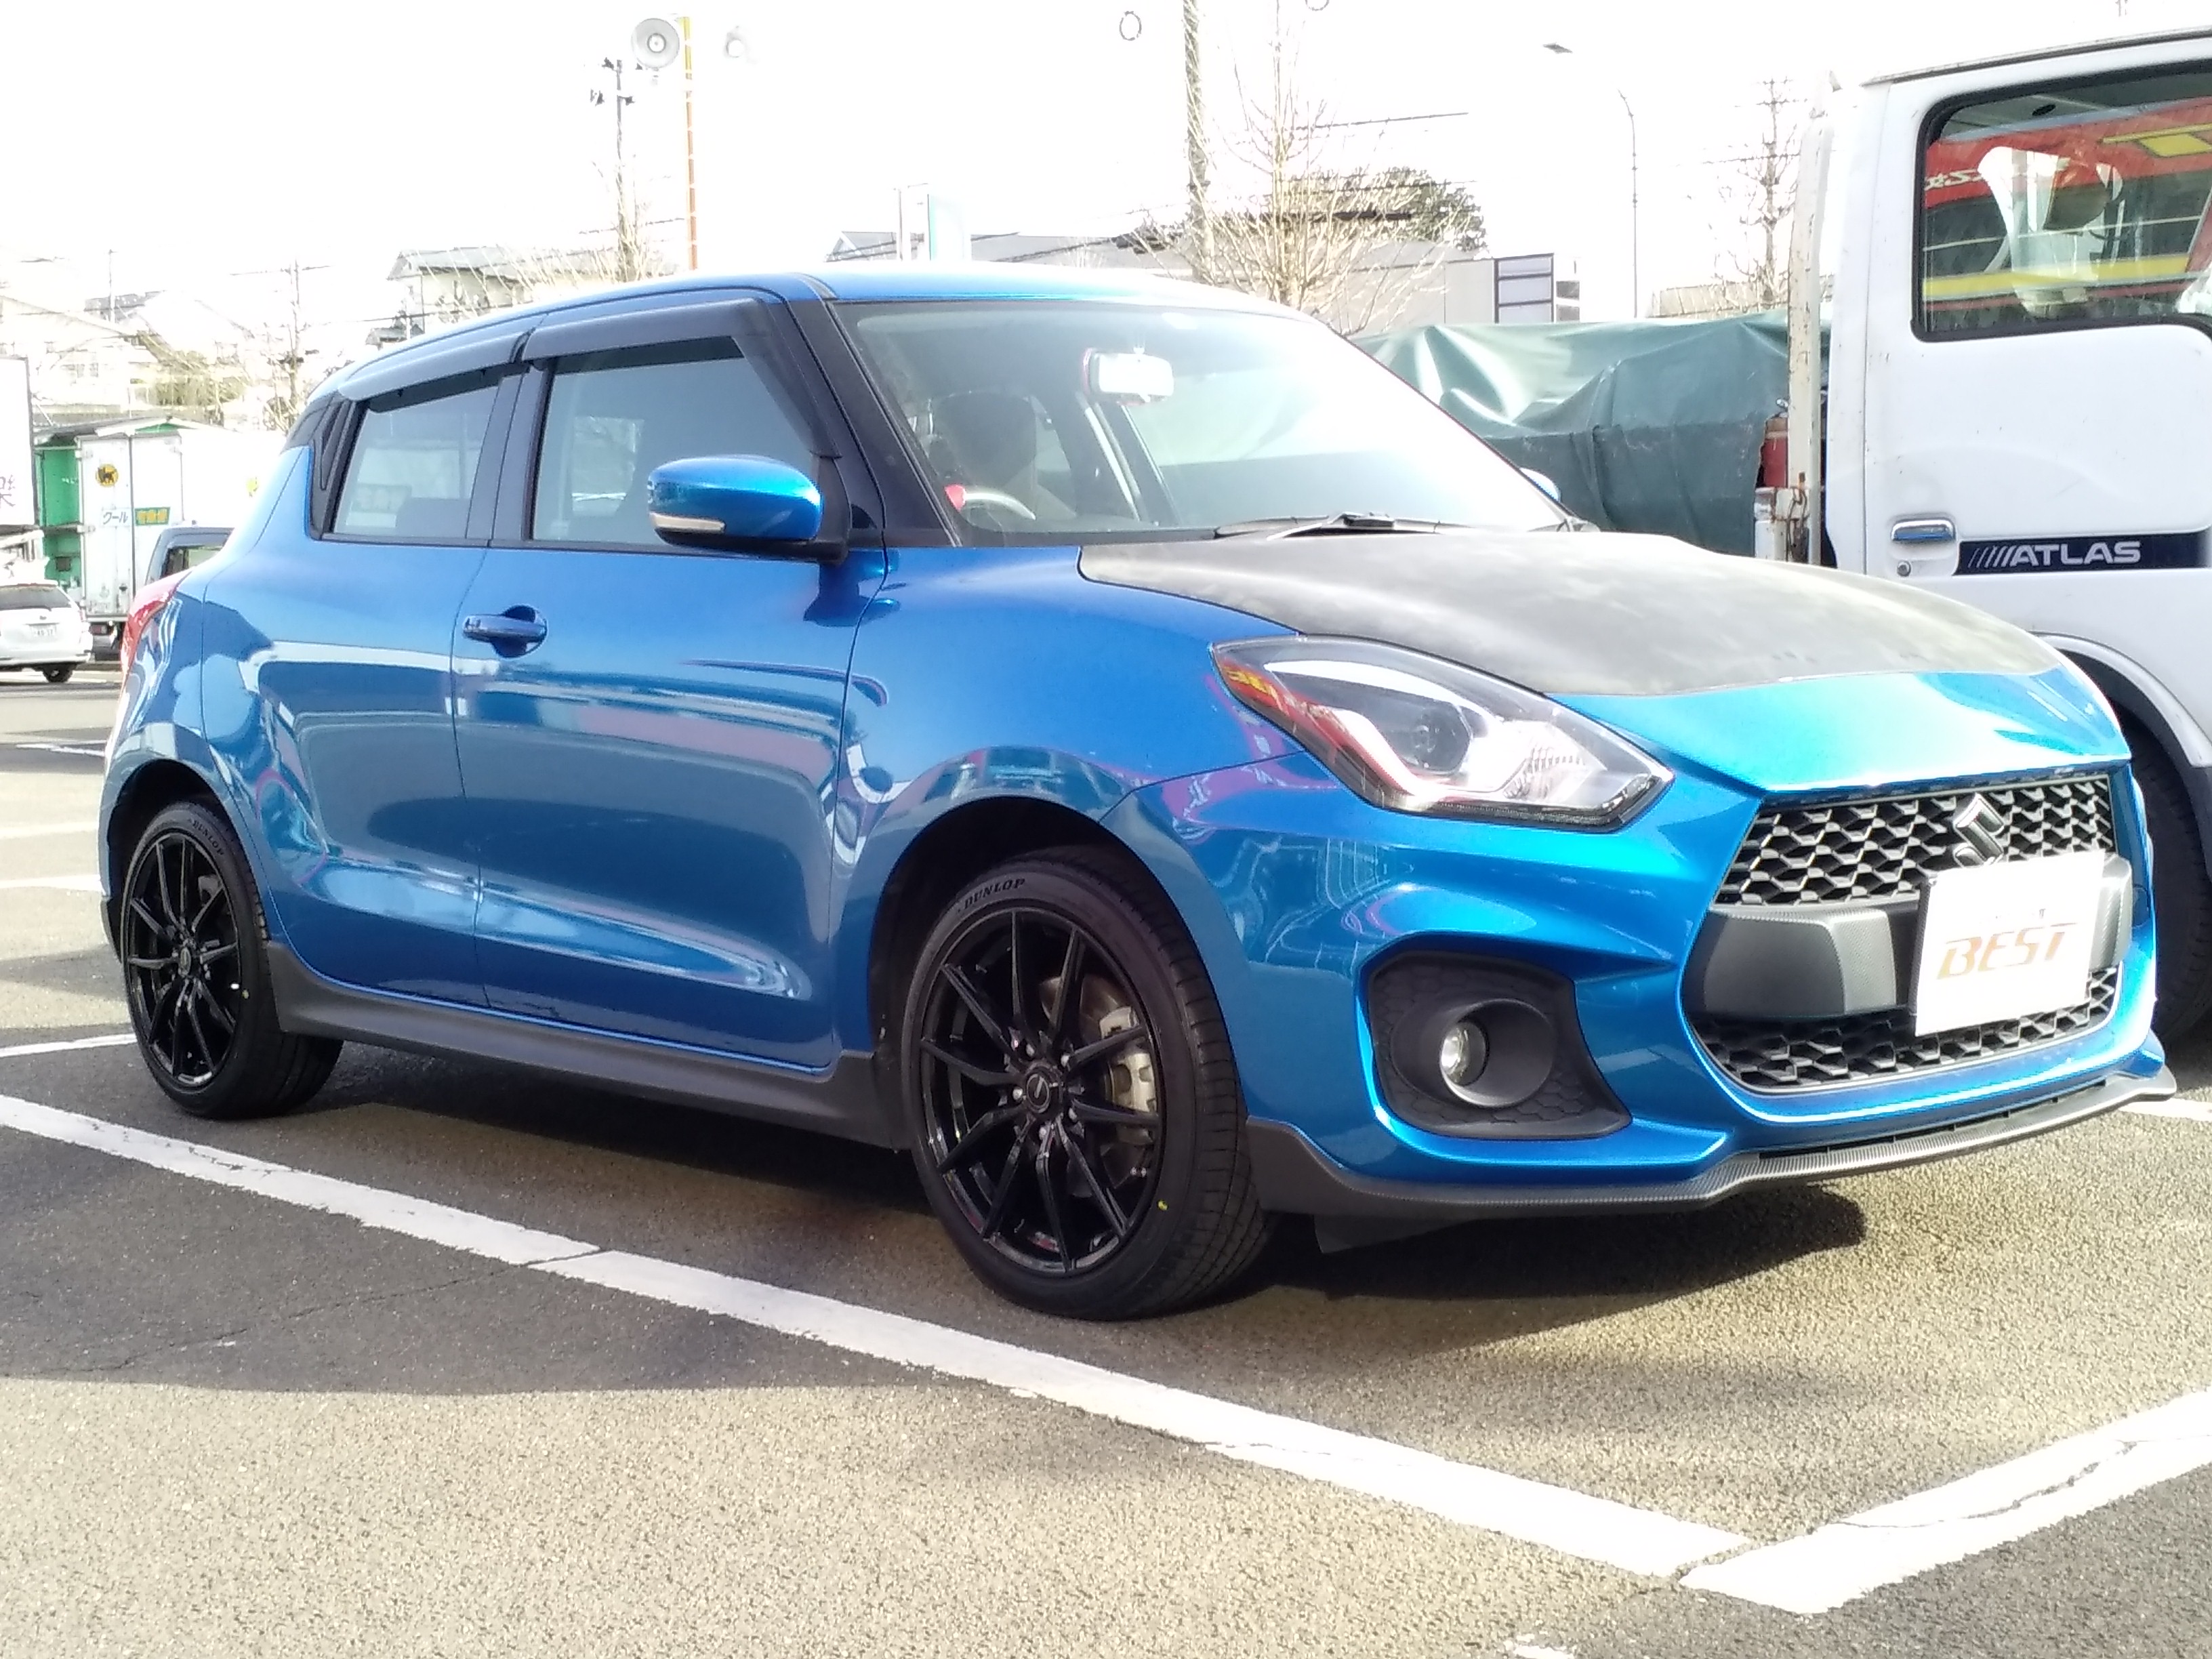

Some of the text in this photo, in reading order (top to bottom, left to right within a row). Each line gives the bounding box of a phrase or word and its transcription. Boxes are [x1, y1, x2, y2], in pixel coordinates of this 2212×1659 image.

[102, 511, 129, 525] クール
[2009, 541, 2141, 567] ATLAS
[964, 878, 1025, 909] DUNLOP
[1936, 922, 2078, 980] BEST
